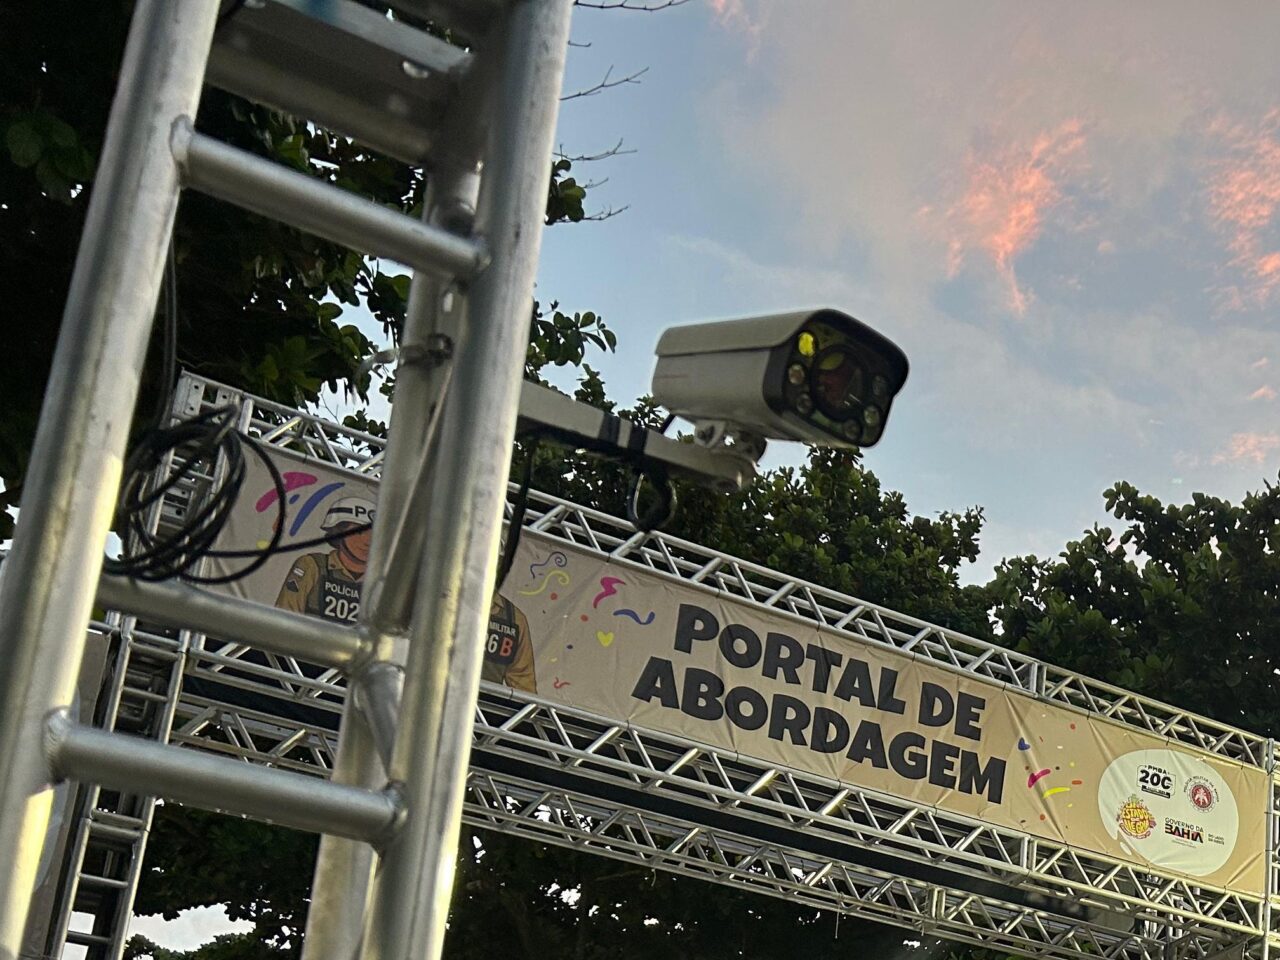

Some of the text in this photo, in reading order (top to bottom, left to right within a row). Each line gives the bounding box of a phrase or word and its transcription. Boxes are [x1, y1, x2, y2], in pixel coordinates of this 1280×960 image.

[324, 581, 360, 599] POLÍCIA
[490, 621, 516, 637] MILITAR
[674, 603, 986, 741] PORTAL DE
[631, 655, 1007, 804] ABORDAGEM
[1164, 817, 1195, 831] GOVERNO
[1164, 823, 1204, 844] BAHIA
